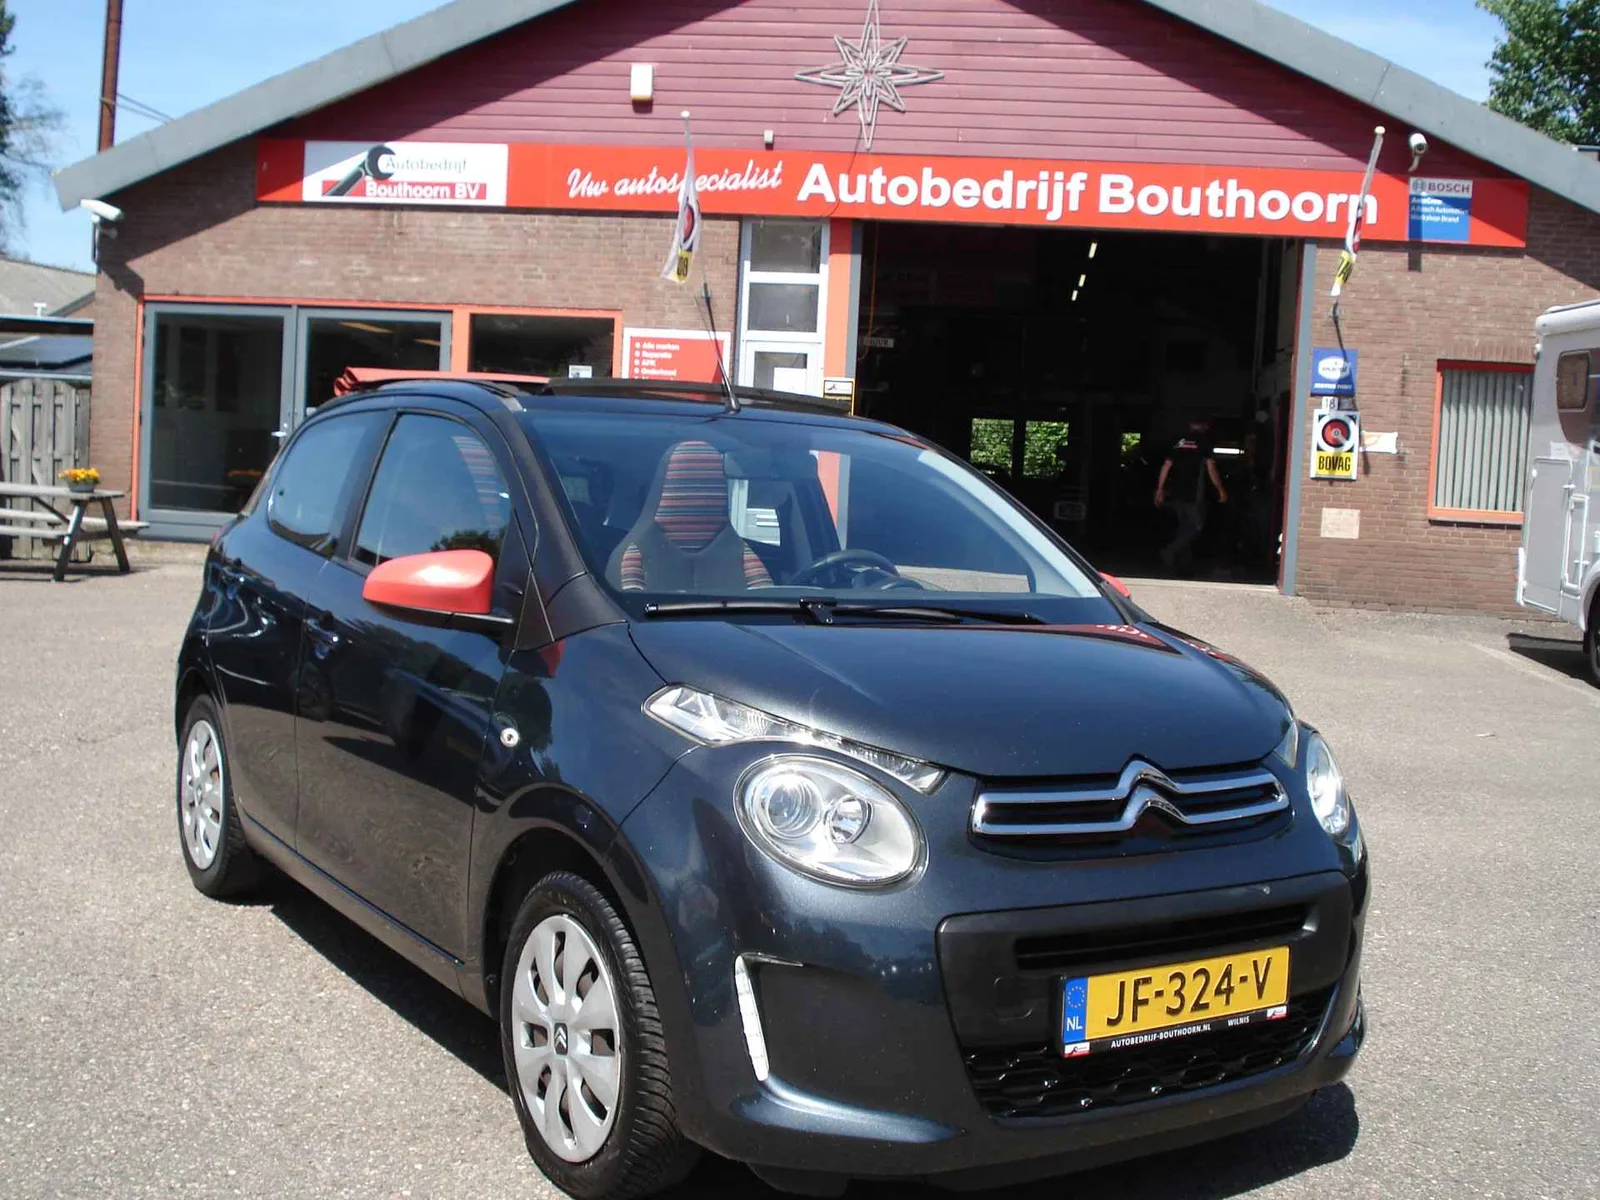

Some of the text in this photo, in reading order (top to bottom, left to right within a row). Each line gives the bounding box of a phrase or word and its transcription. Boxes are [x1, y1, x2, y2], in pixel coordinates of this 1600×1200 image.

[364, 180, 480, 199] Bouthoorn BV
[567, 159, 783, 198] Uw autosecialist
[1427, 182, 1470, 193] BOSCH
[797, 162, 1378, 225] Autobedrijf Bouthoorn
[1318, 455, 1351, 473] BOVAG
[1106, 957, 1272, 1027] JF-324-V
[1066, 1016, 1083, 1032] NL
[1110, 1015, 1250, 1050] AUTOBEDRIJF-BOUTHOORN.NL WILNIS
